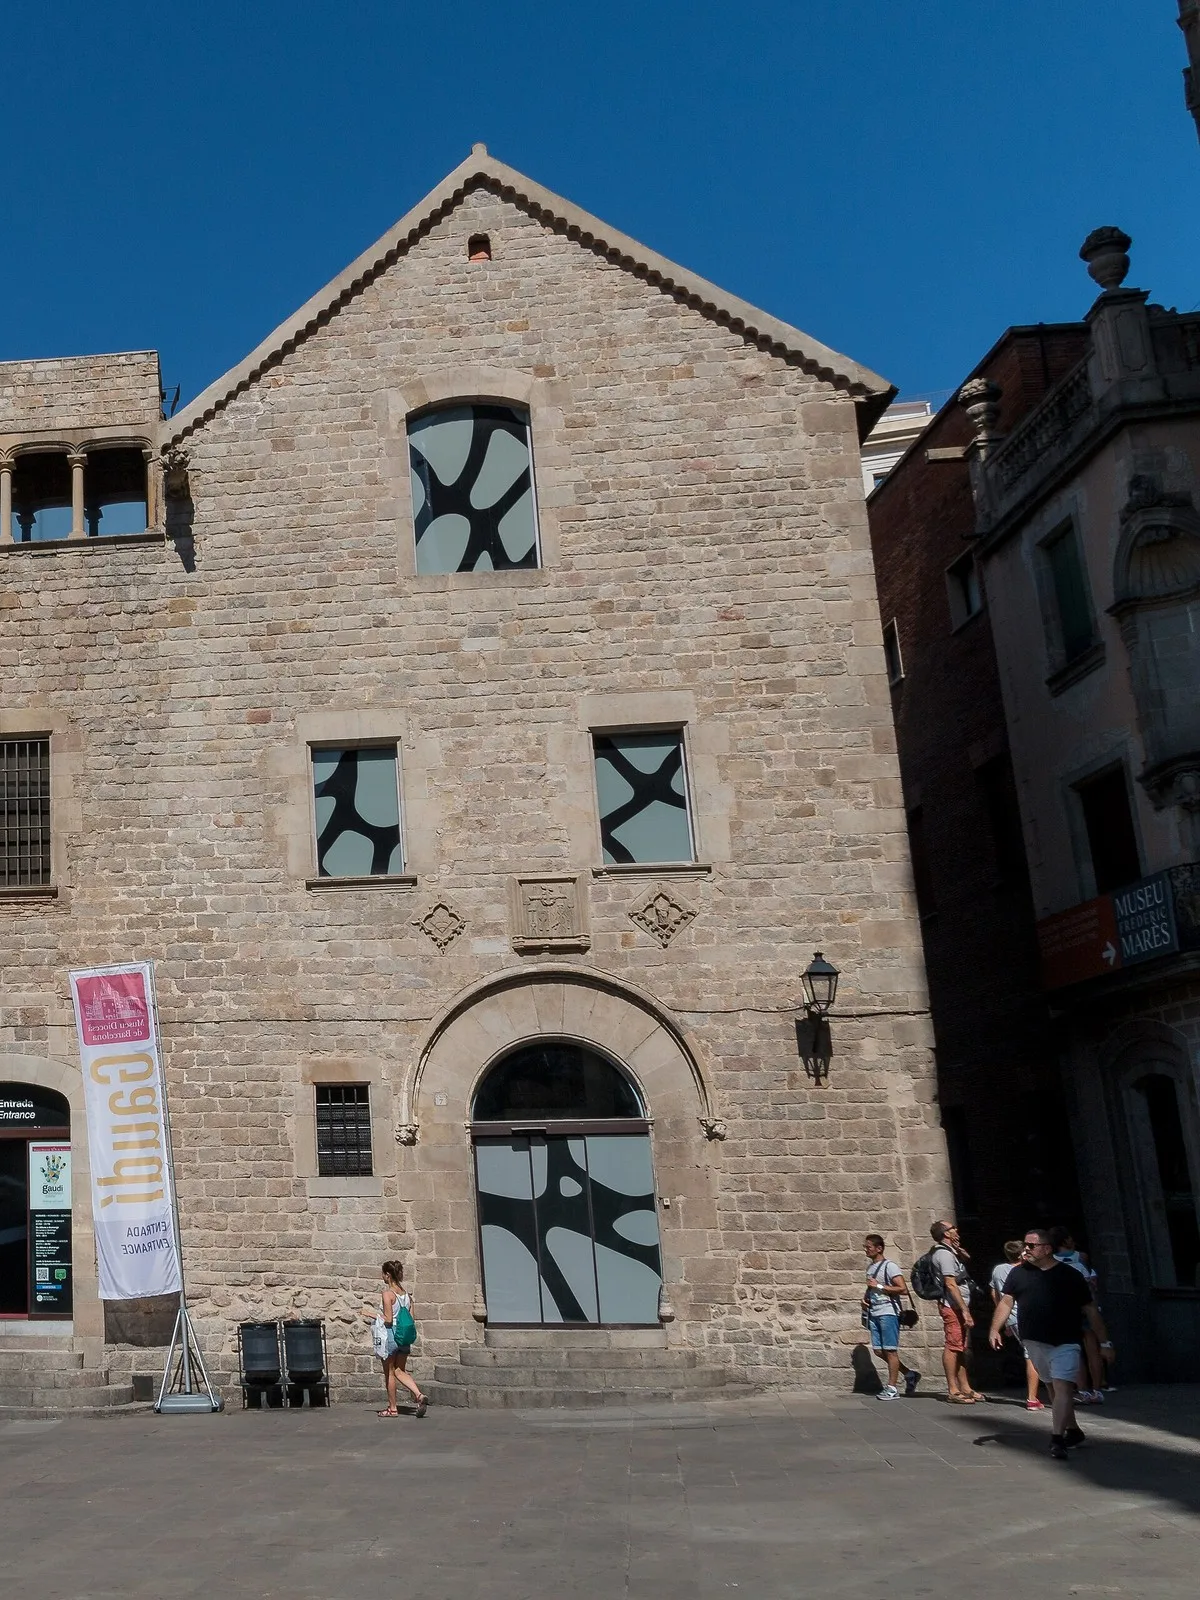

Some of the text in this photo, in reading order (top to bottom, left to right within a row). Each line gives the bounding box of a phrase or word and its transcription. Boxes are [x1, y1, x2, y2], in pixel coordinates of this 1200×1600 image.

[1115, 880, 1164, 919] MUSEU
[1119, 905, 1167, 933] FREDERIC
[1121, 921, 1171, 959] MARÈS
